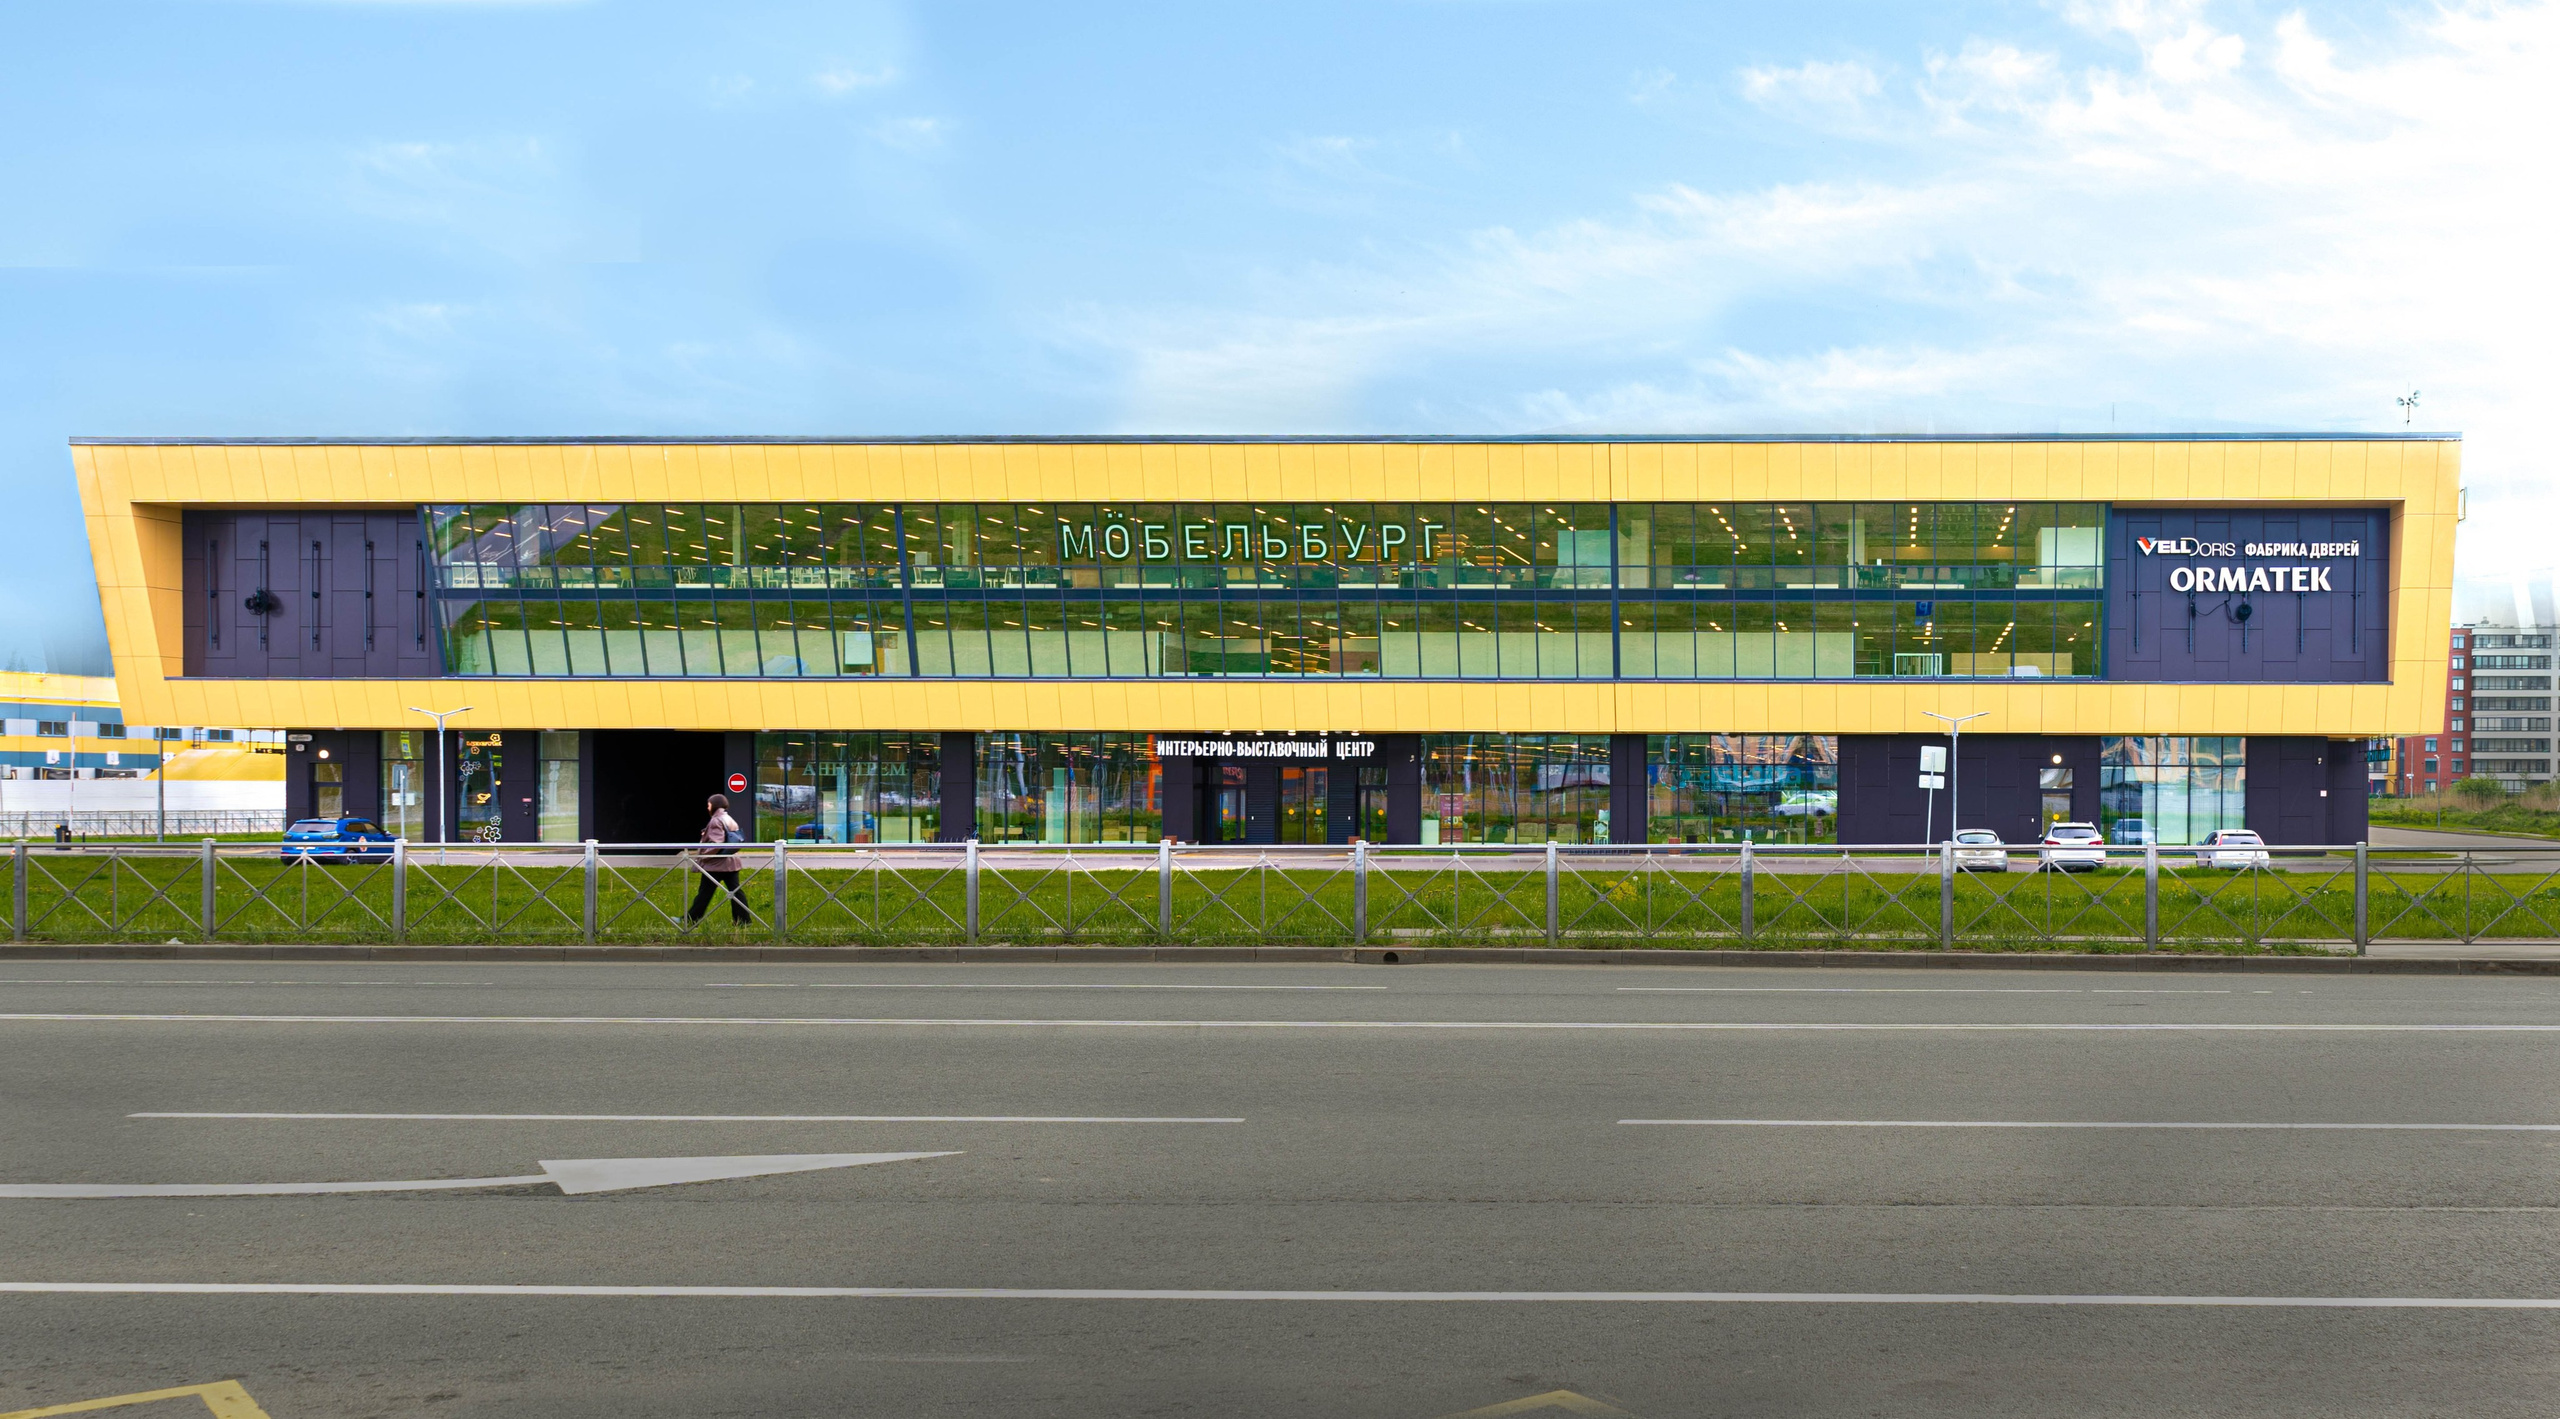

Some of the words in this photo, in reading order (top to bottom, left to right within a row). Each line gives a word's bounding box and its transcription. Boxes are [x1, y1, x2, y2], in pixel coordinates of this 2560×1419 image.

[2244, 541, 2308, 557] ФАБРИКА
[2310, 540, 2360, 558] ДВЕРЕЙ
[2169, 566, 2332, 592] ORMATEK
[1157, 739, 1327, 758] ИНТЕРЬЕРНО-ВЫСТАВОЧНЫЙ
[1335, 741, 1374, 760] ЦЕНТР
